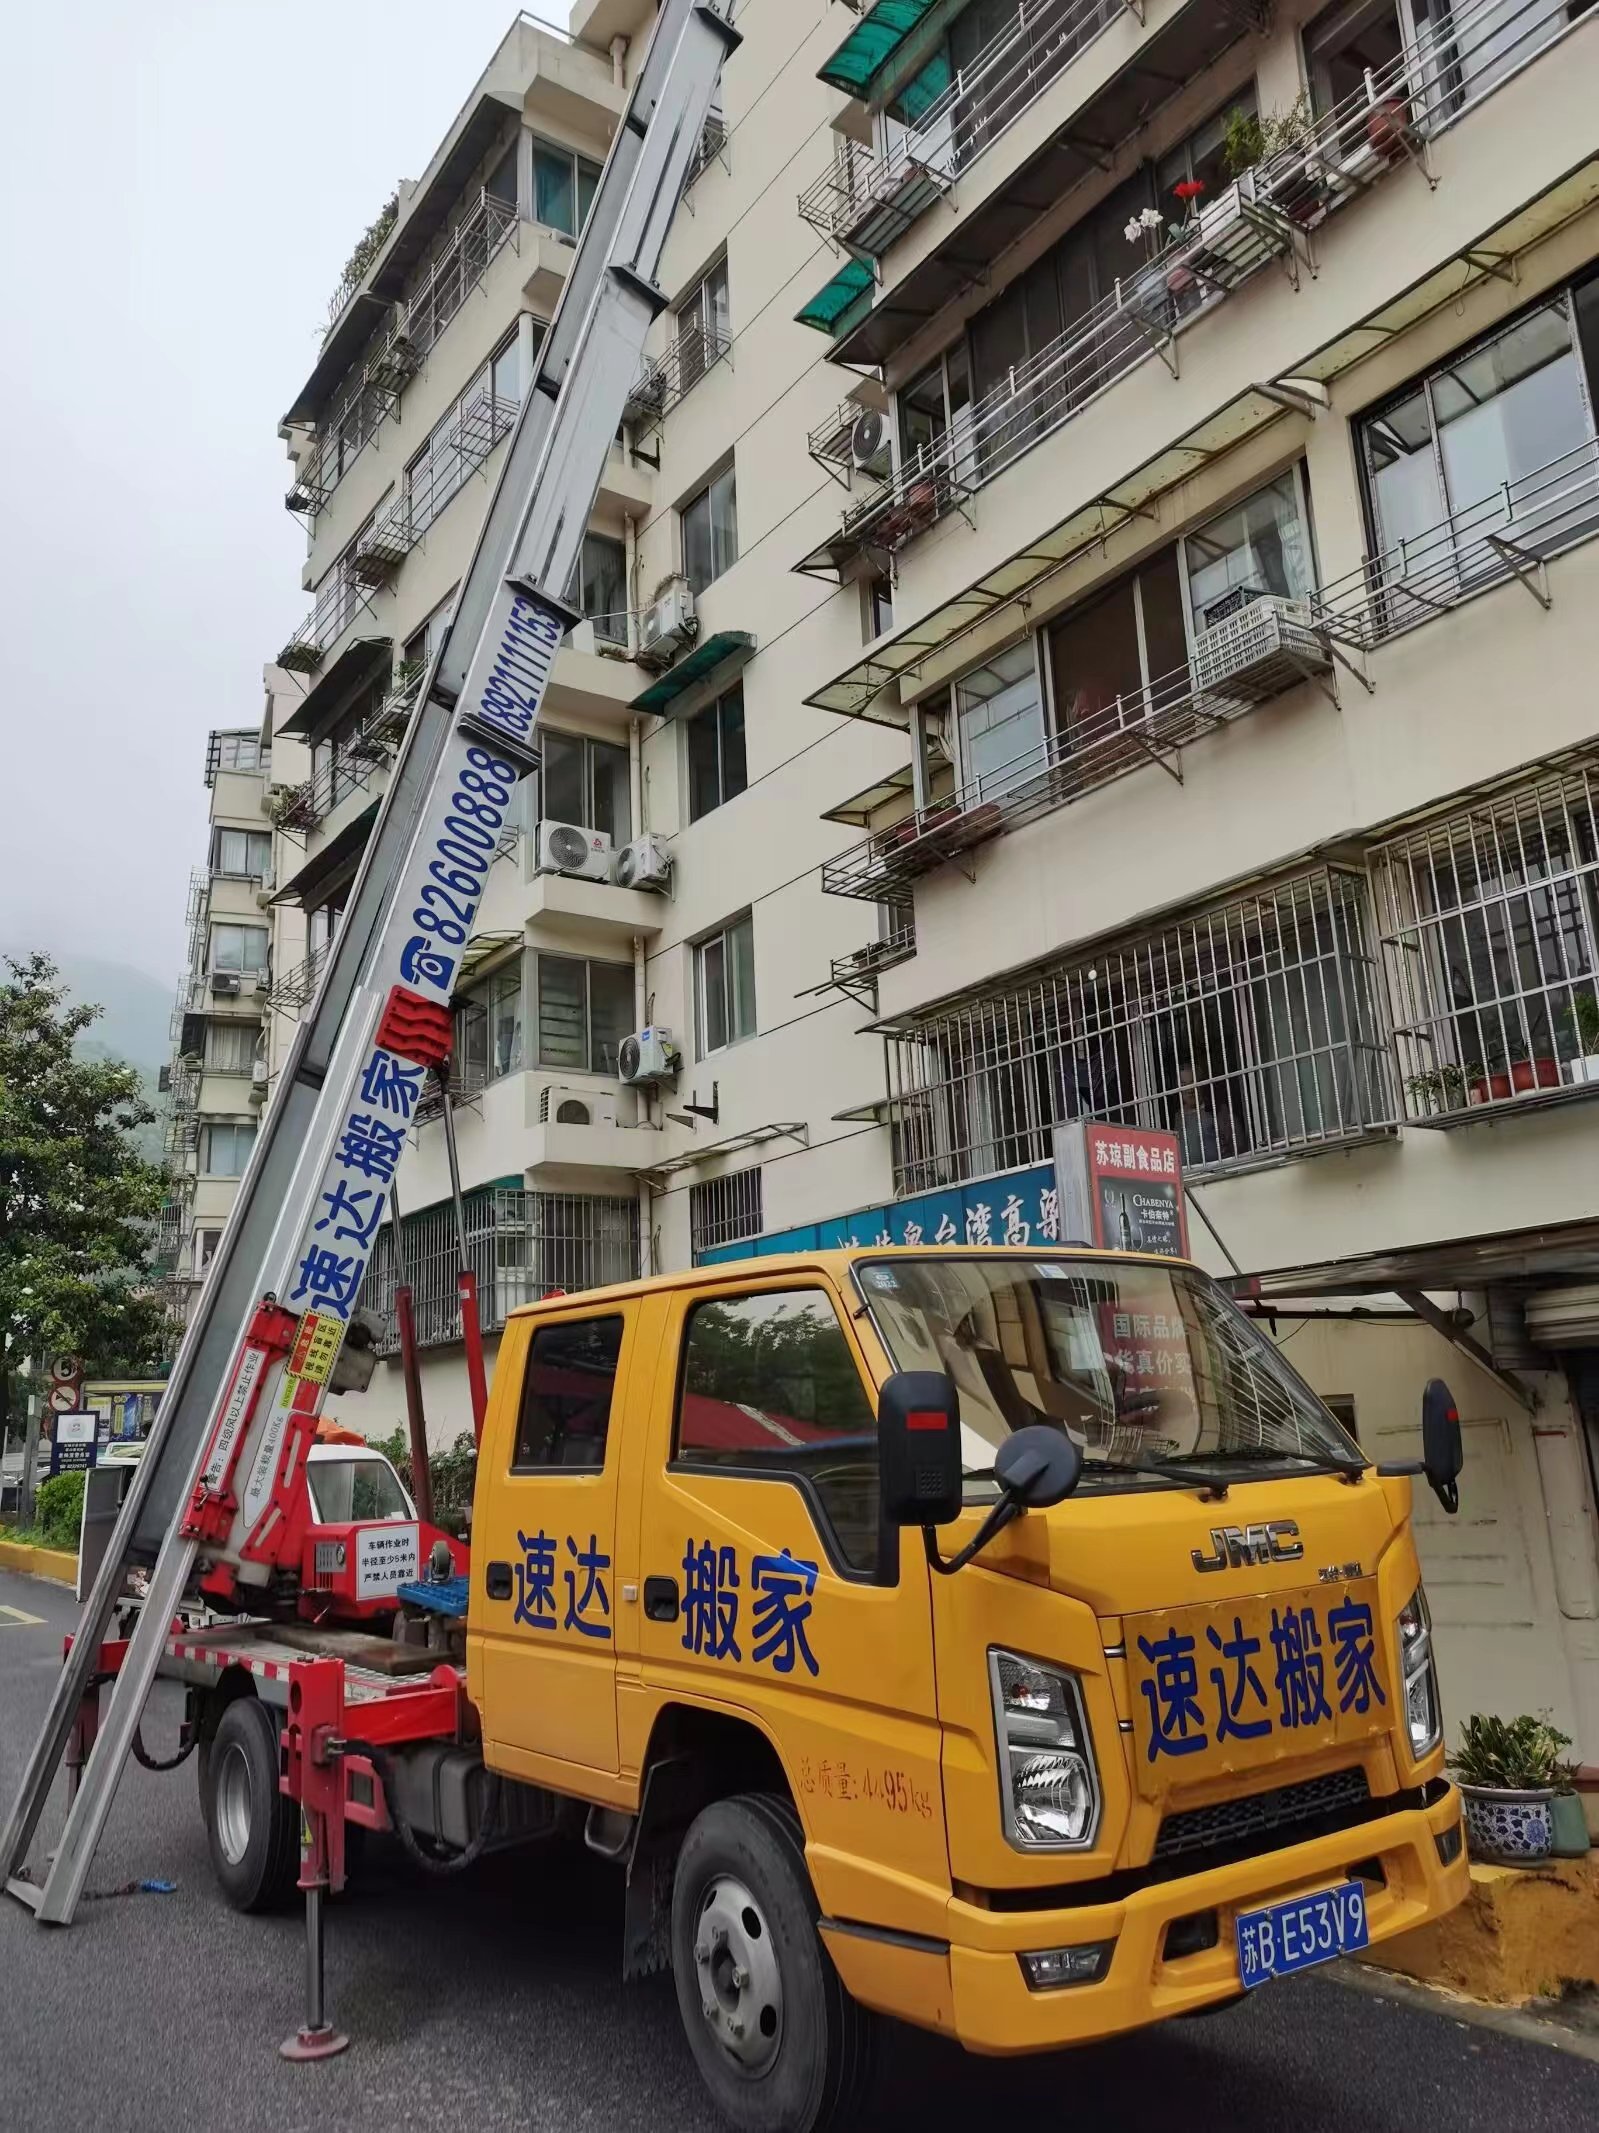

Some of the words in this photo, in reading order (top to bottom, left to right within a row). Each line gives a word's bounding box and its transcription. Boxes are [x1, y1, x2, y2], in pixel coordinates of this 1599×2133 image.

[412, 746, 517, 946] 82600888
[1095, 1140, 1175, 1174] 苏琼副食品店
[289, 1049, 426, 1320] 速达搬家
[1132, 1194, 1174, 1209] CHABENYA
[60, 1361, 72, 1377] 5
[361, 1552, 416, 1567] 半径至少5米内
[368, 1538, 409, 1550] 车辆作业时
[1191, 1519, 1304, 1573] JMC
[363, 1568, 414, 1583] 严禁人员靠近
[513, 1529, 612, 1640] 速达
[681, 1537, 820, 1678] 搬家
[1137, 1595, 1387, 1764] 速达搬家
